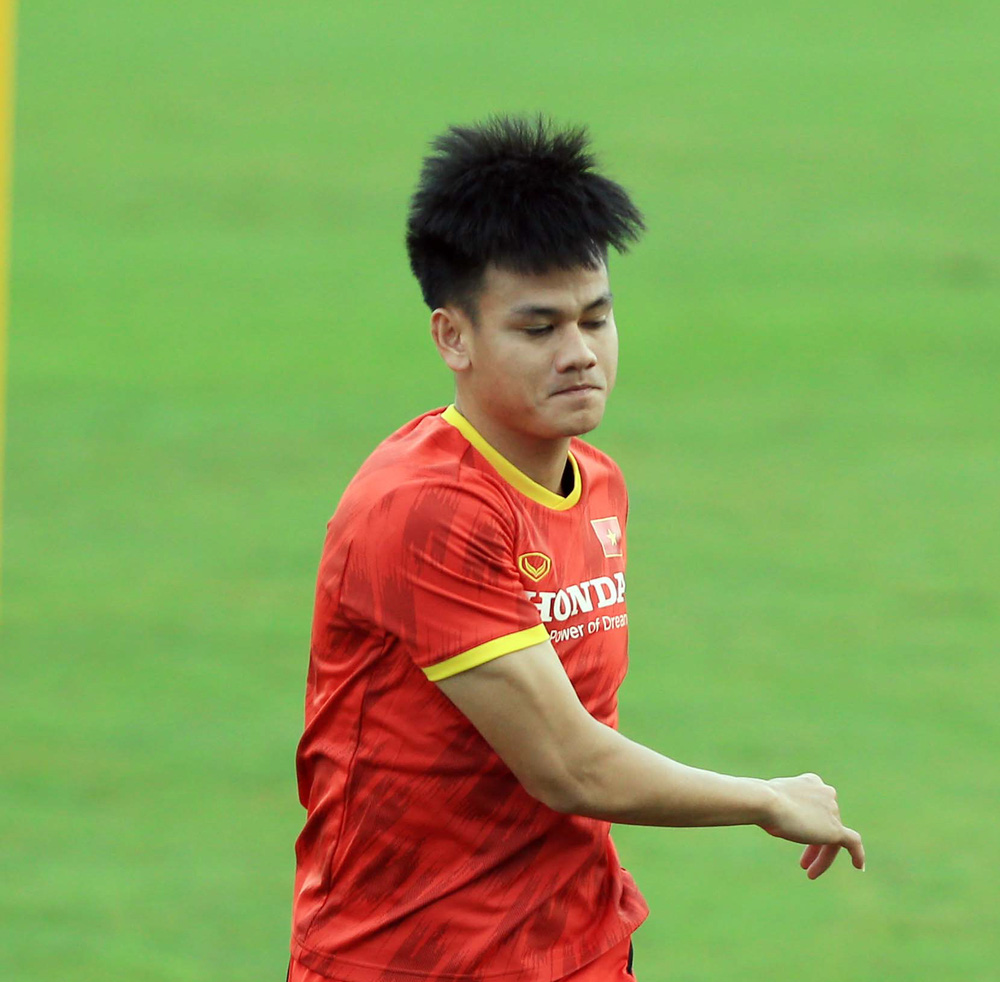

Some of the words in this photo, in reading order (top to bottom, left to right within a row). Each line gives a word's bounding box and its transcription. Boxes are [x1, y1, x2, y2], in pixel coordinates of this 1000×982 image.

[524, 572, 626, 622] HONDA
[550, 624, 584, 642] Power
[587, 617, 600, 634] of
